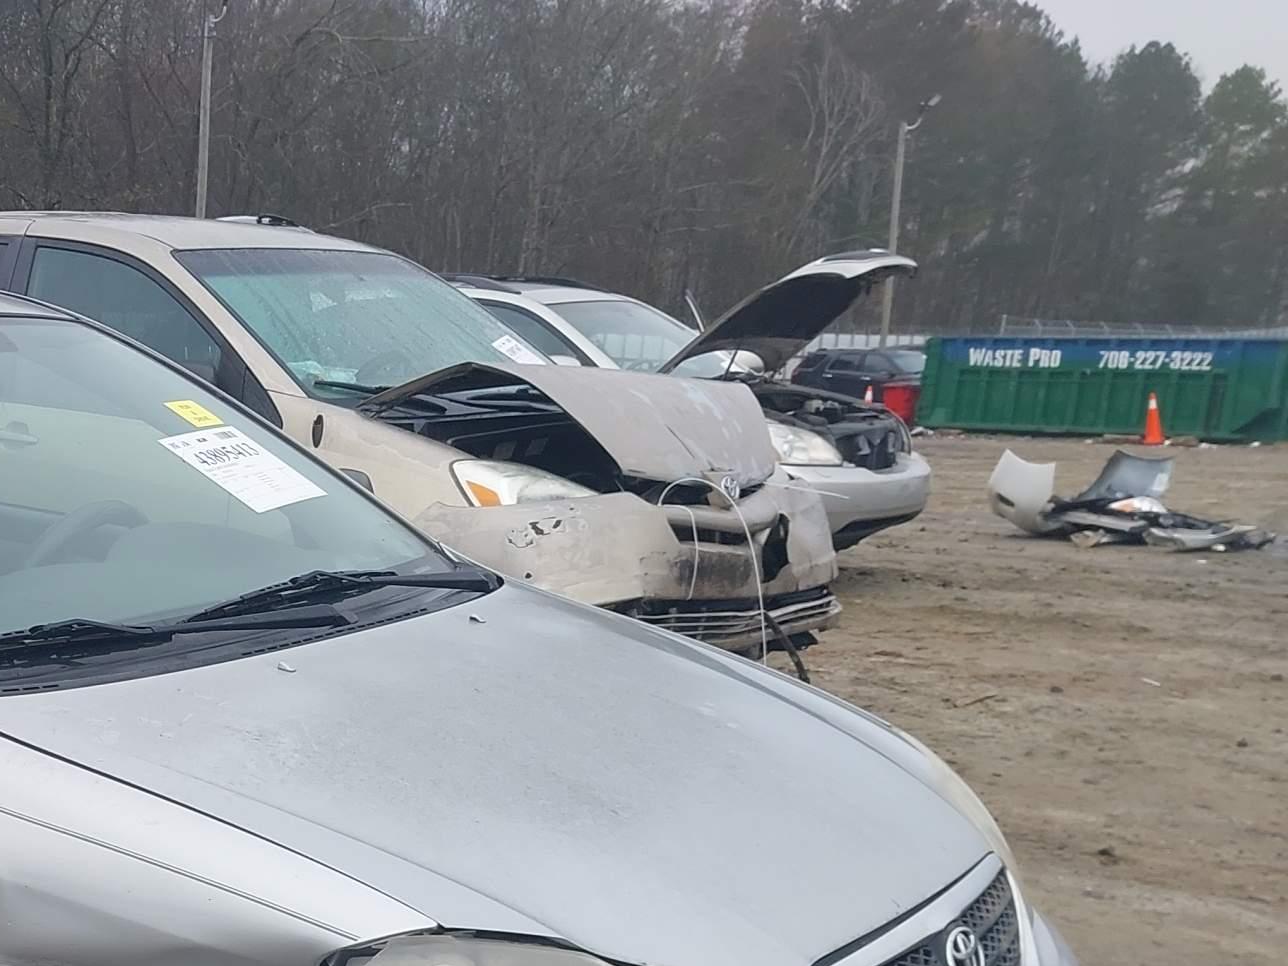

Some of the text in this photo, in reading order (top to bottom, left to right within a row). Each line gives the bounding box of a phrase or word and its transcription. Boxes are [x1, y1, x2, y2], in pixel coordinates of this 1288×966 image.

[969, 348, 1024, 367] WASTE
[1028, 347, 1062, 368] PRO
[193, 442, 260, 466] 43895413
